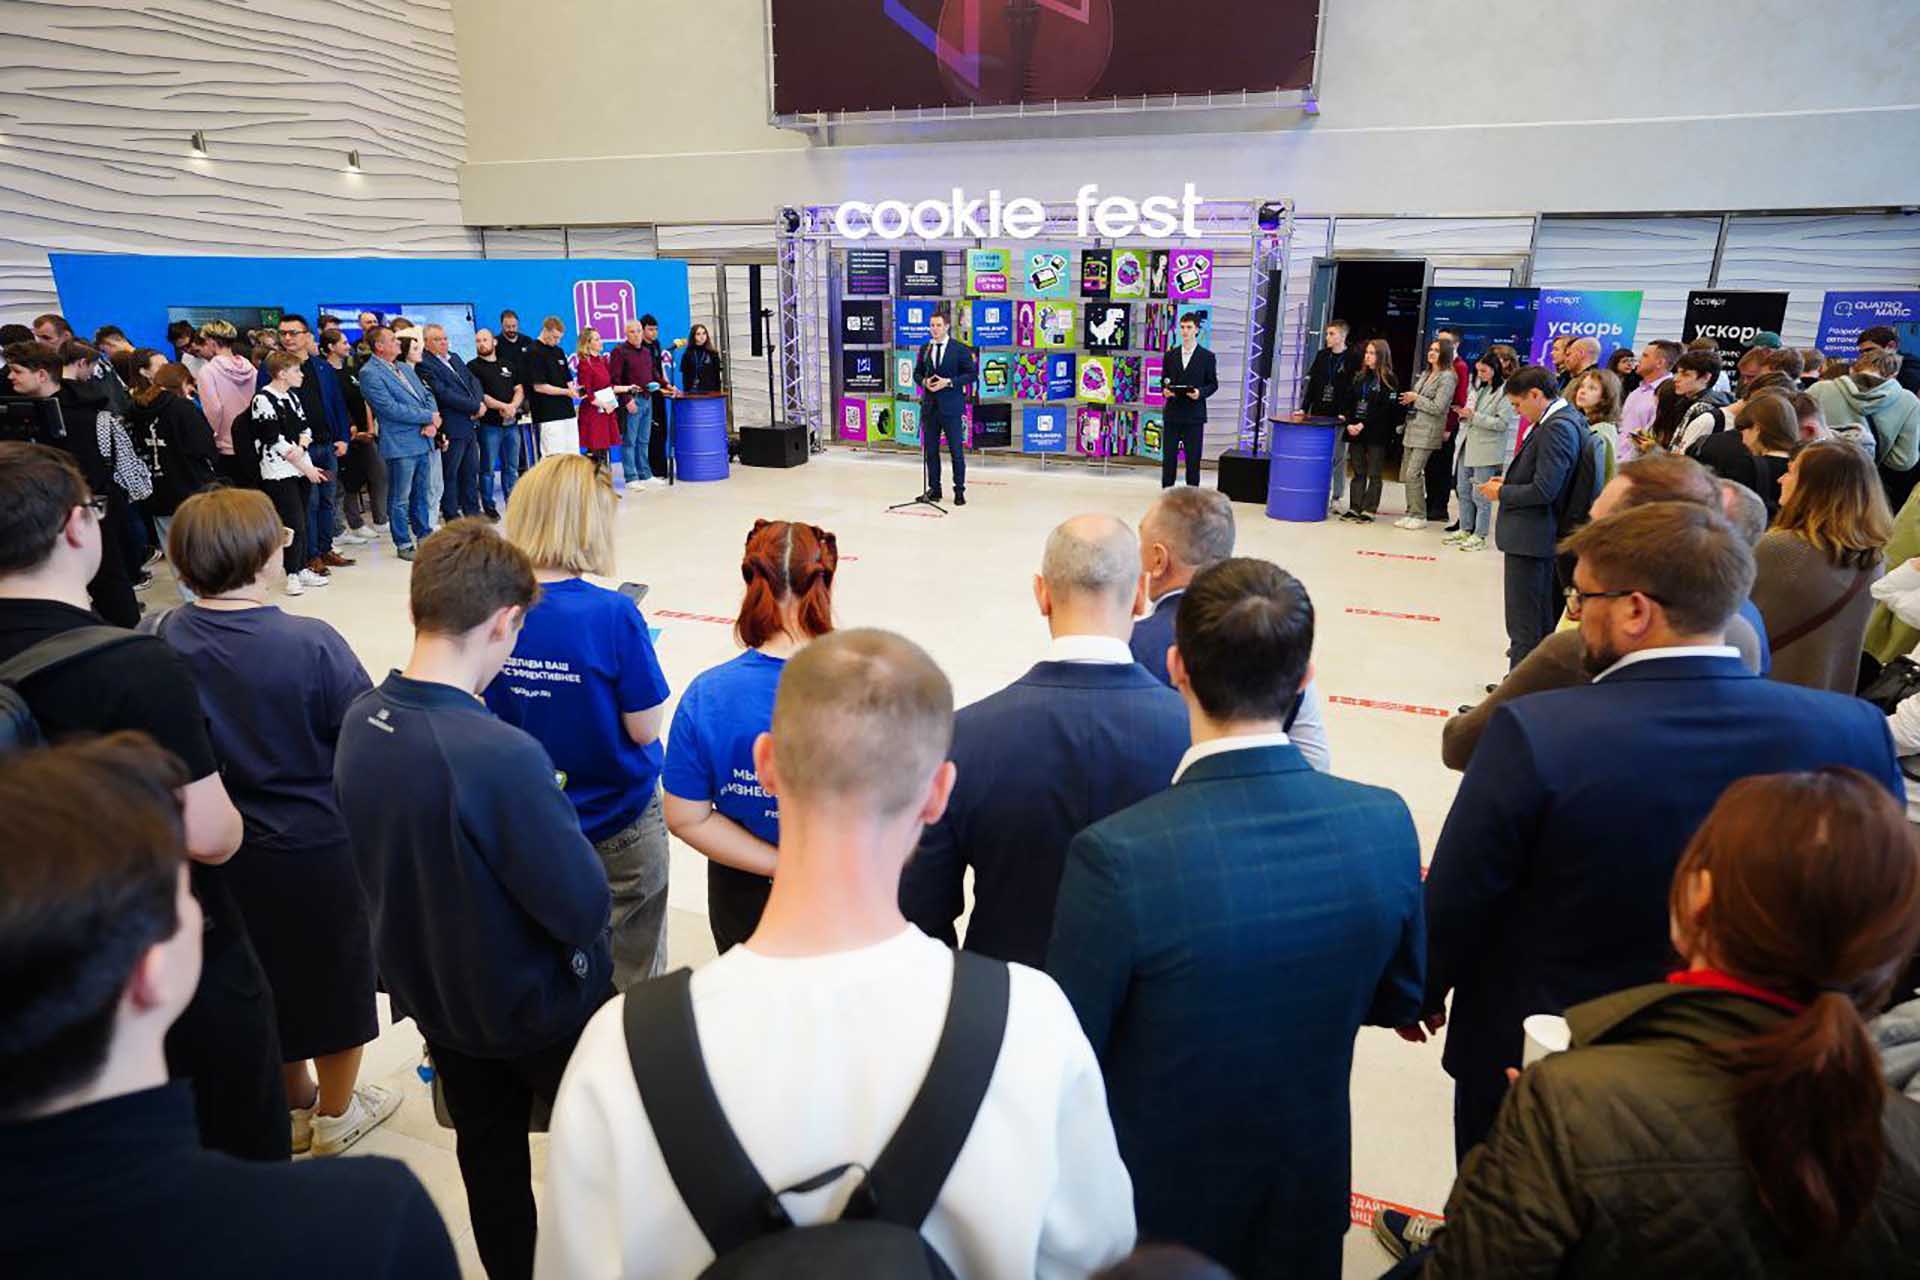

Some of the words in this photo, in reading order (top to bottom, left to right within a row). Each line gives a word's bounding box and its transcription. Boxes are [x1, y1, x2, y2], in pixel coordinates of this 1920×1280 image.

[834, 187, 1046, 240] cookie
[1075, 182, 1204, 239] fest
[1854, 301, 1903, 310] QUATRO
[1874, 308, 1912, 317] MATIC
[1548, 321, 1623, 338] ускорь
